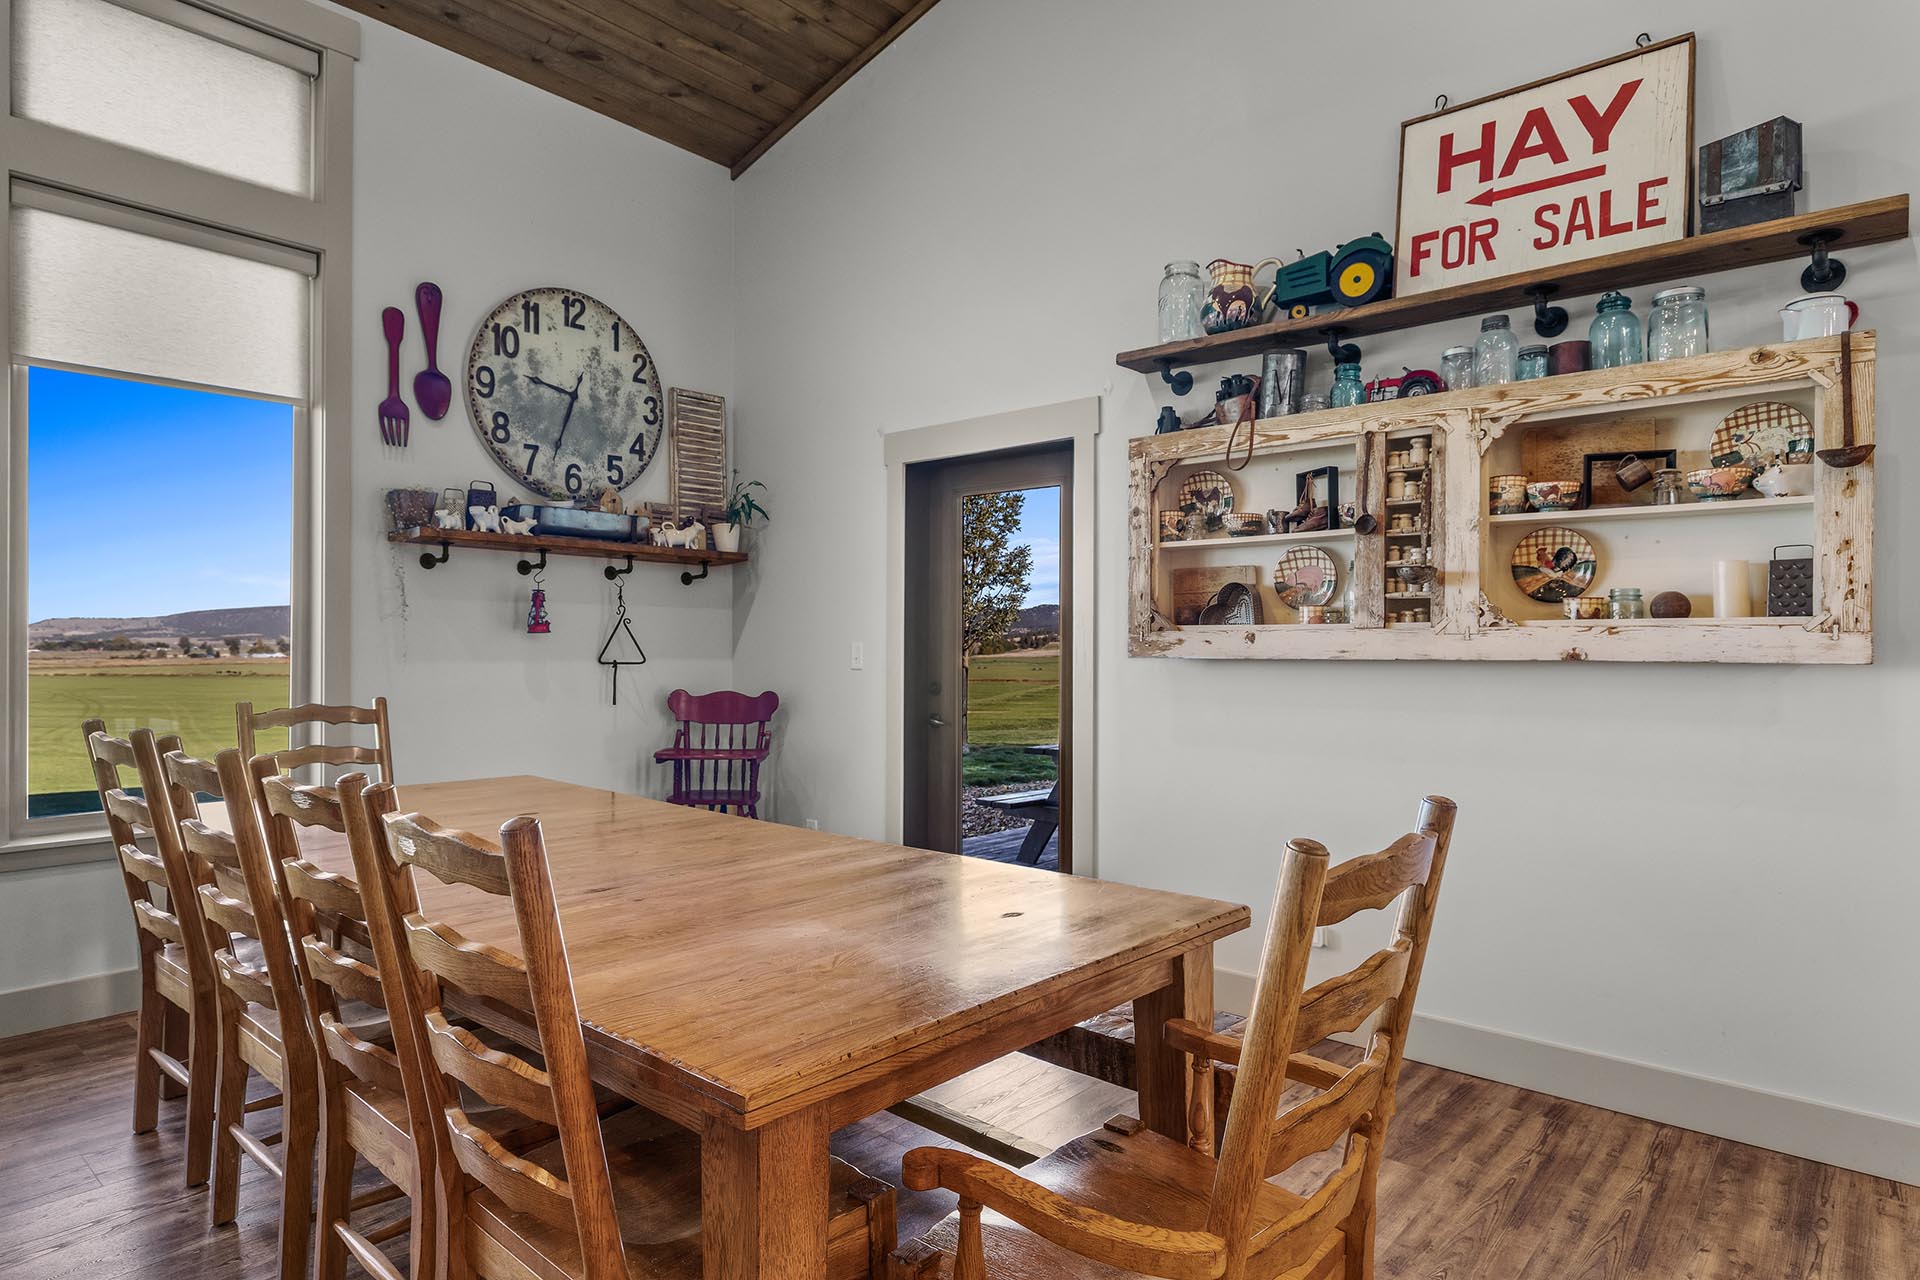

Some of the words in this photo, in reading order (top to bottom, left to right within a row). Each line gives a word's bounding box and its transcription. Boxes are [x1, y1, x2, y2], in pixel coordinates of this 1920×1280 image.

[1437, 79, 1643, 194] HAY
[1410, 217, 1499, 277] FOR
[1533, 177, 1668, 250] SALE
[522, 300, 540, 335] 11
[561, 296, 585, 331] 12
[491, 323, 520, 359] 10
[611, 321, 620, 352] 1
[475, 366, 496, 399] 9
[632, 353, 648, 384] 2
[1270, 369, 1297, 407] M
[491, 411, 511, 444] 8
[642, 396, 659, 426] 3
[523, 444, 540, 476] 7
[629, 433, 647, 462] 4
[564, 464, 583, 494] 6
[607, 455, 624, 486] 5
